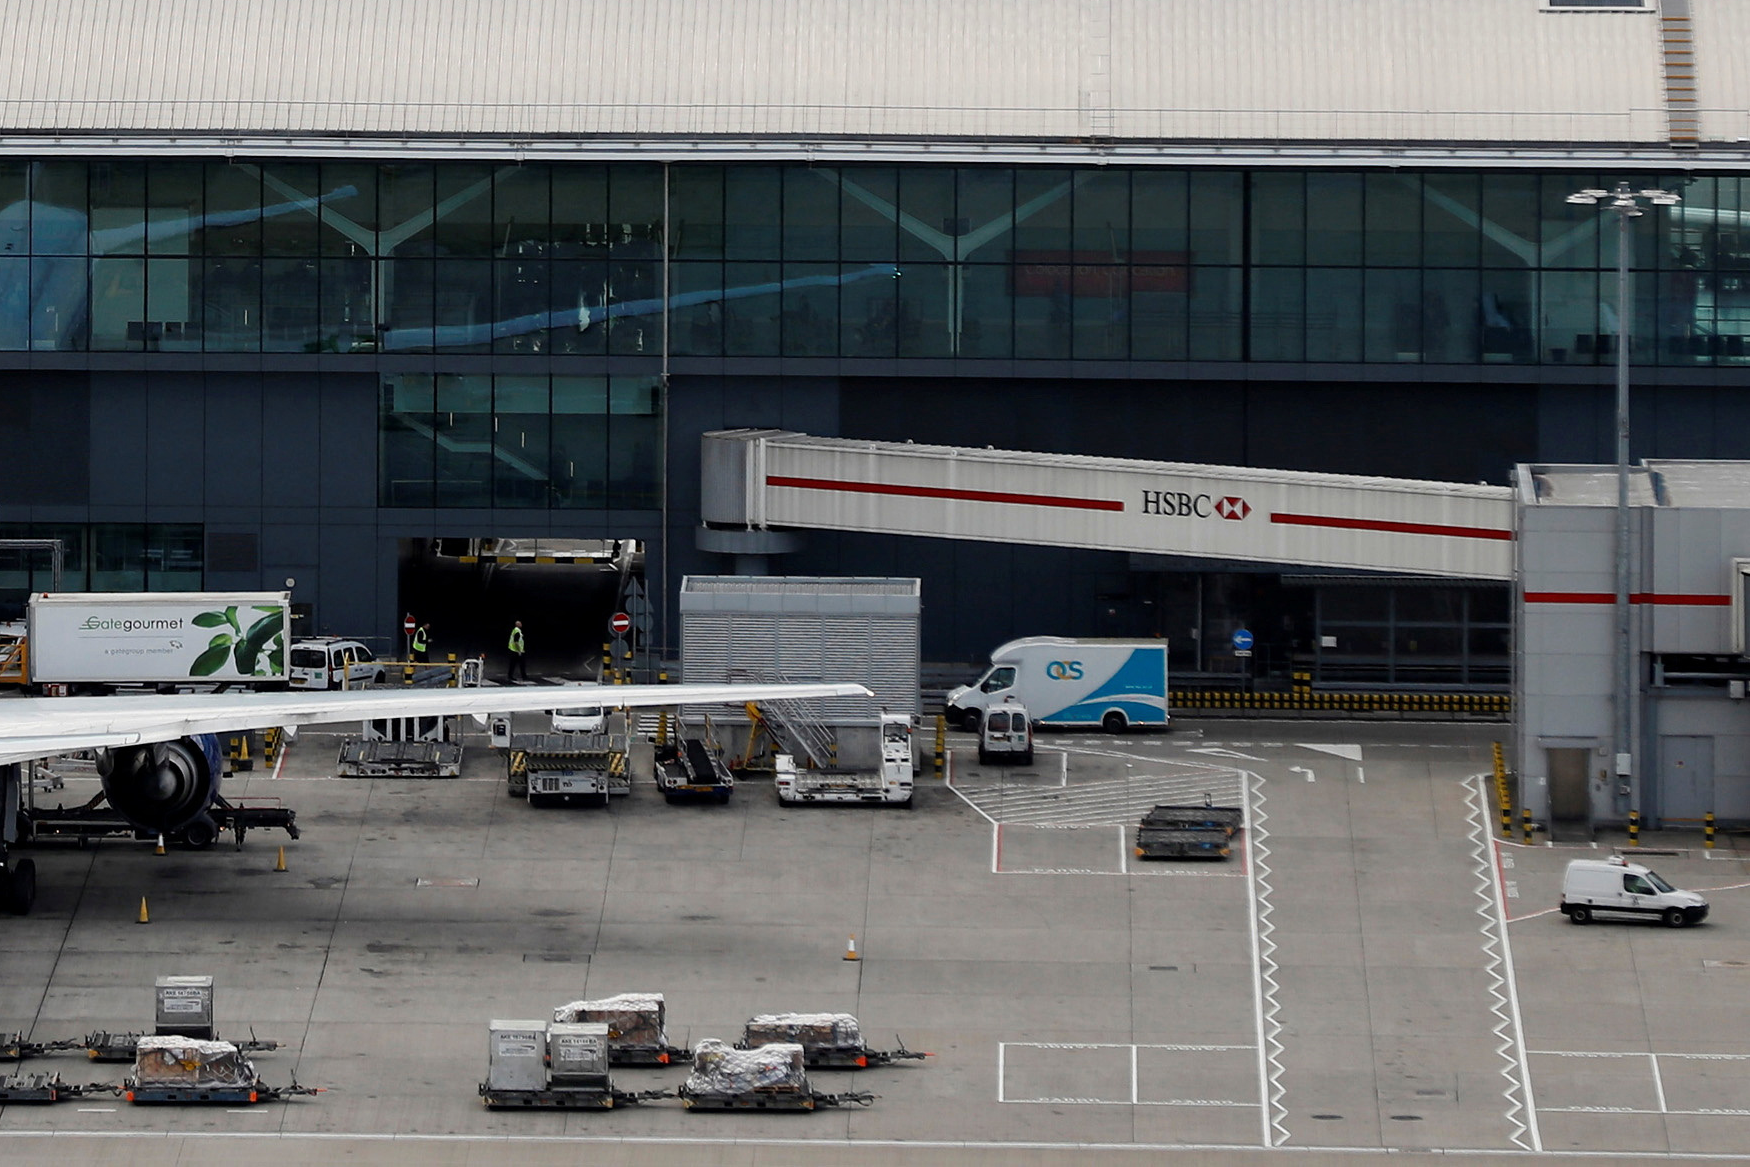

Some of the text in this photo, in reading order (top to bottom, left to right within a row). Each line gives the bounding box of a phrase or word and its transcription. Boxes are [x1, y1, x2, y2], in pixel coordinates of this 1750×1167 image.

[1142, 489, 1213, 519] HSBC
[79, 616, 183, 632] Gategourmet
[1046, 661, 1084, 680] OCS
